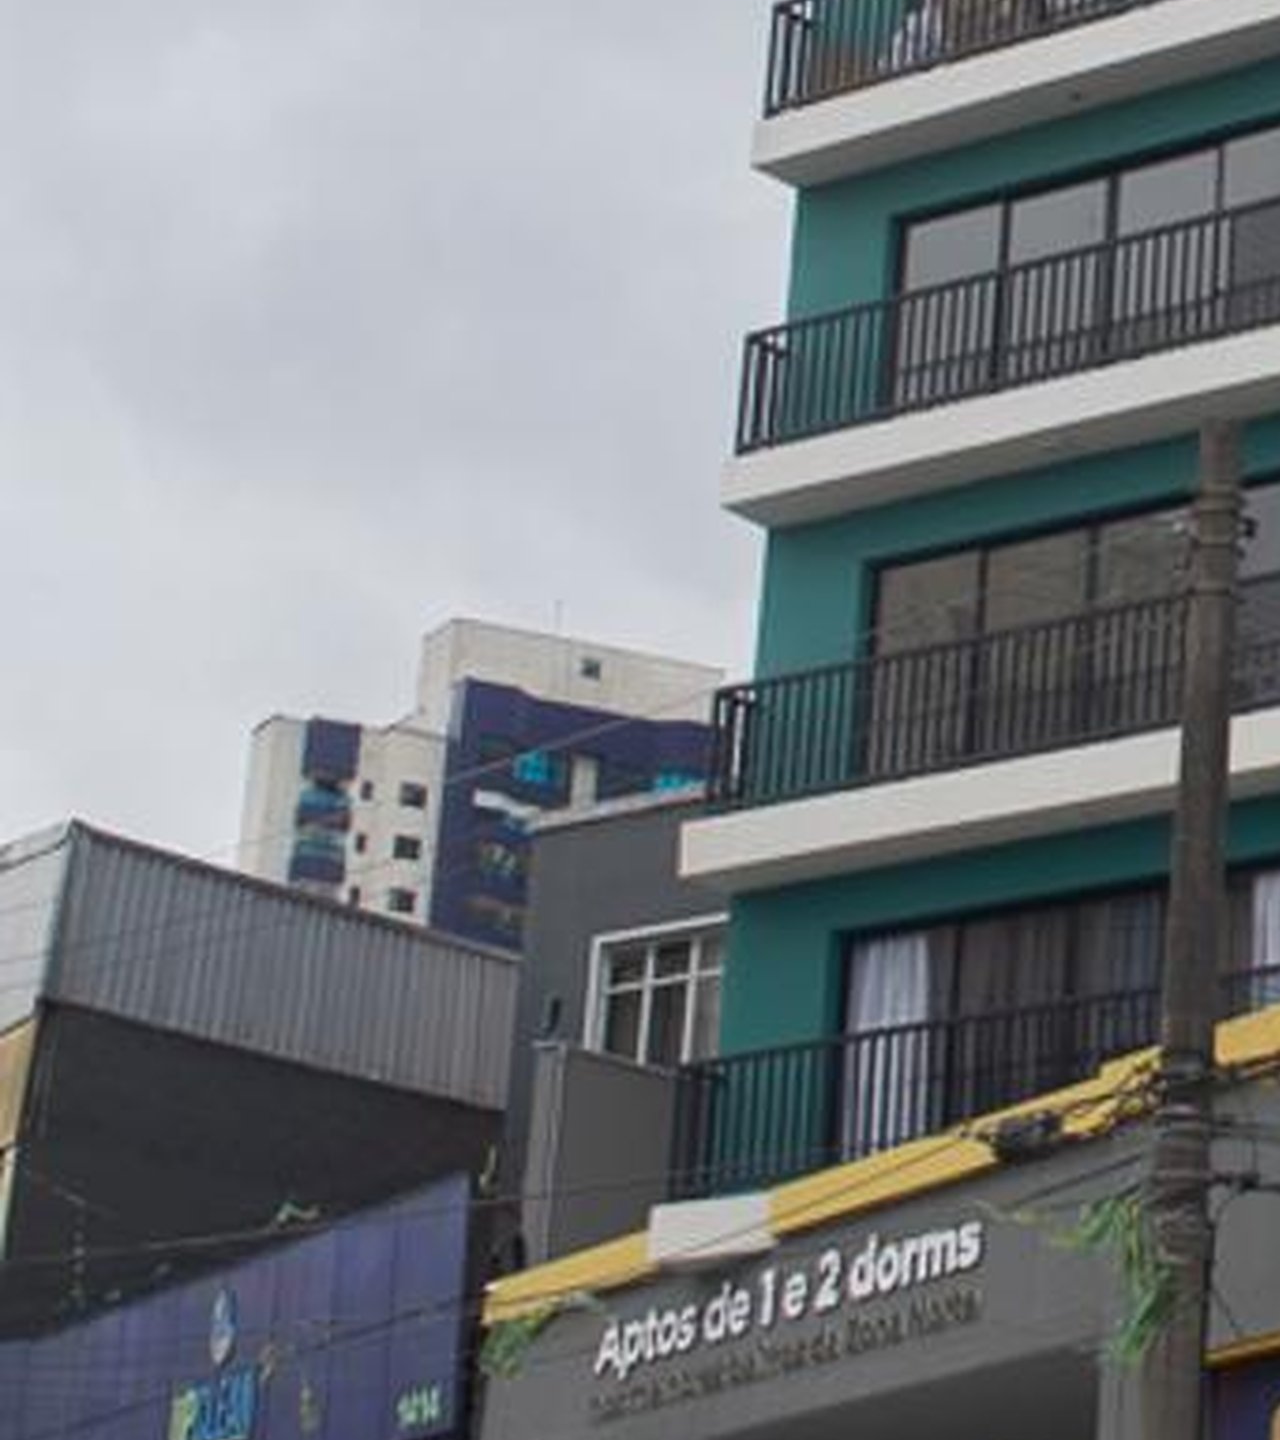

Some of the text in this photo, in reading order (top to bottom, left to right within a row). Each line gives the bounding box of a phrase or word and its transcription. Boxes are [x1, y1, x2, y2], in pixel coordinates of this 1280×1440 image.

[594, 1301, 700, 1380] Aptos
[703, 1280, 751, 1341] de
[757, 1268, 777, 1325] 1
[782, 1271, 808, 1317] e
[812, 1248, 843, 1310] 2
[847, 1220, 983, 1298] dorms
